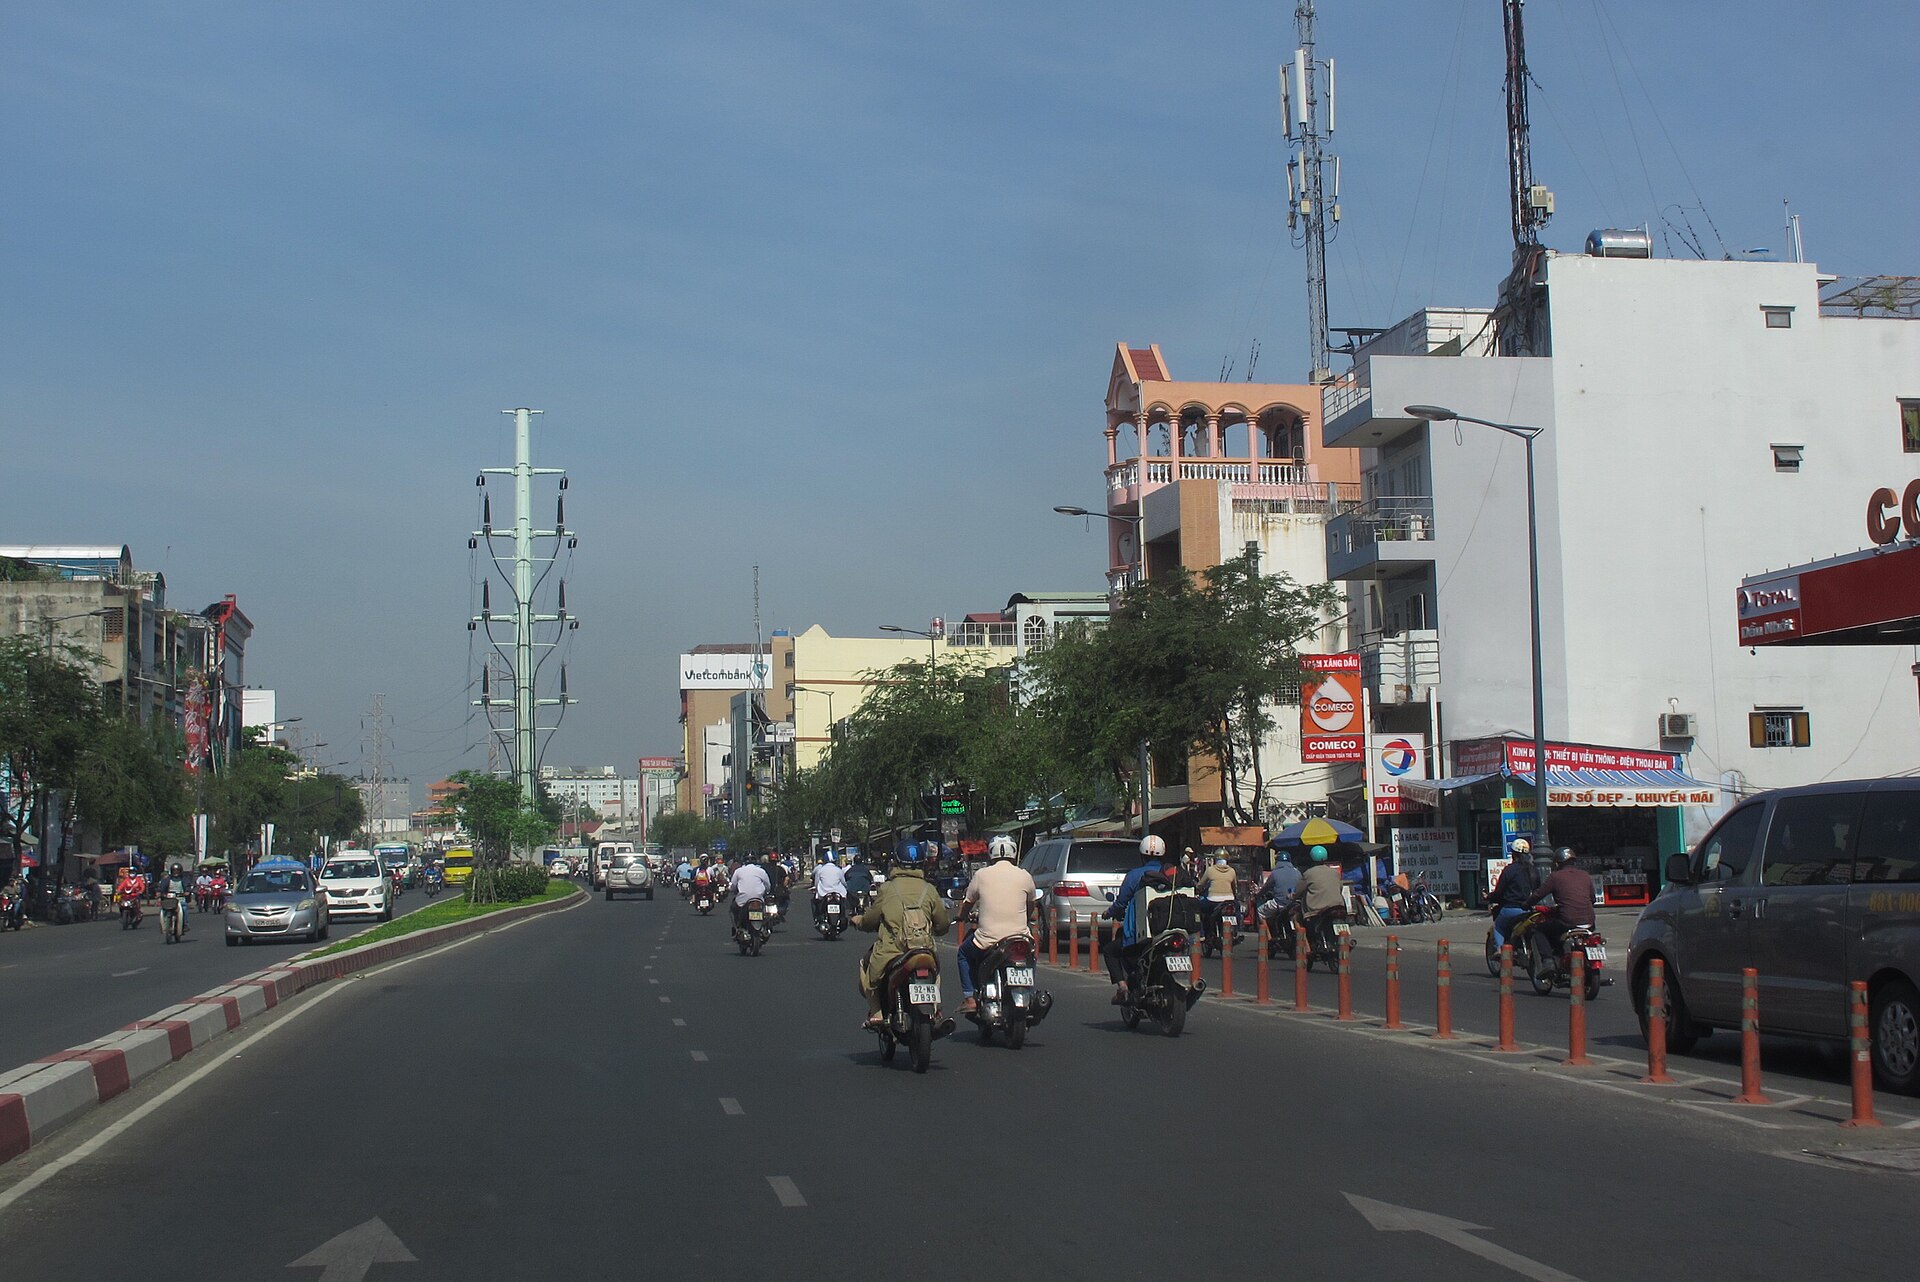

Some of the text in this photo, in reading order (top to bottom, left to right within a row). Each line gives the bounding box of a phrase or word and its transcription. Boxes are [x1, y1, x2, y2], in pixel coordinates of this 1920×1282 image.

[1752, 589, 1796, 608] TOTAL
[684, 669, 750, 680] Vietcombank
[1314, 703, 1355, 712] COMECO
[1309, 740, 1357, 750] COMECO
[1512, 747, 1528, 757] KINH
[1549, 792, 1572, 802] SIM
[1576, 790, 1594, 802] SỐ
[1597, 793, 1624, 804] ĐẸP
[1636, 790, 1686, 802] KHUYẾN
[1690, 791, 1714, 803] MÃI
[914, 994, 937, 1002] 7839
